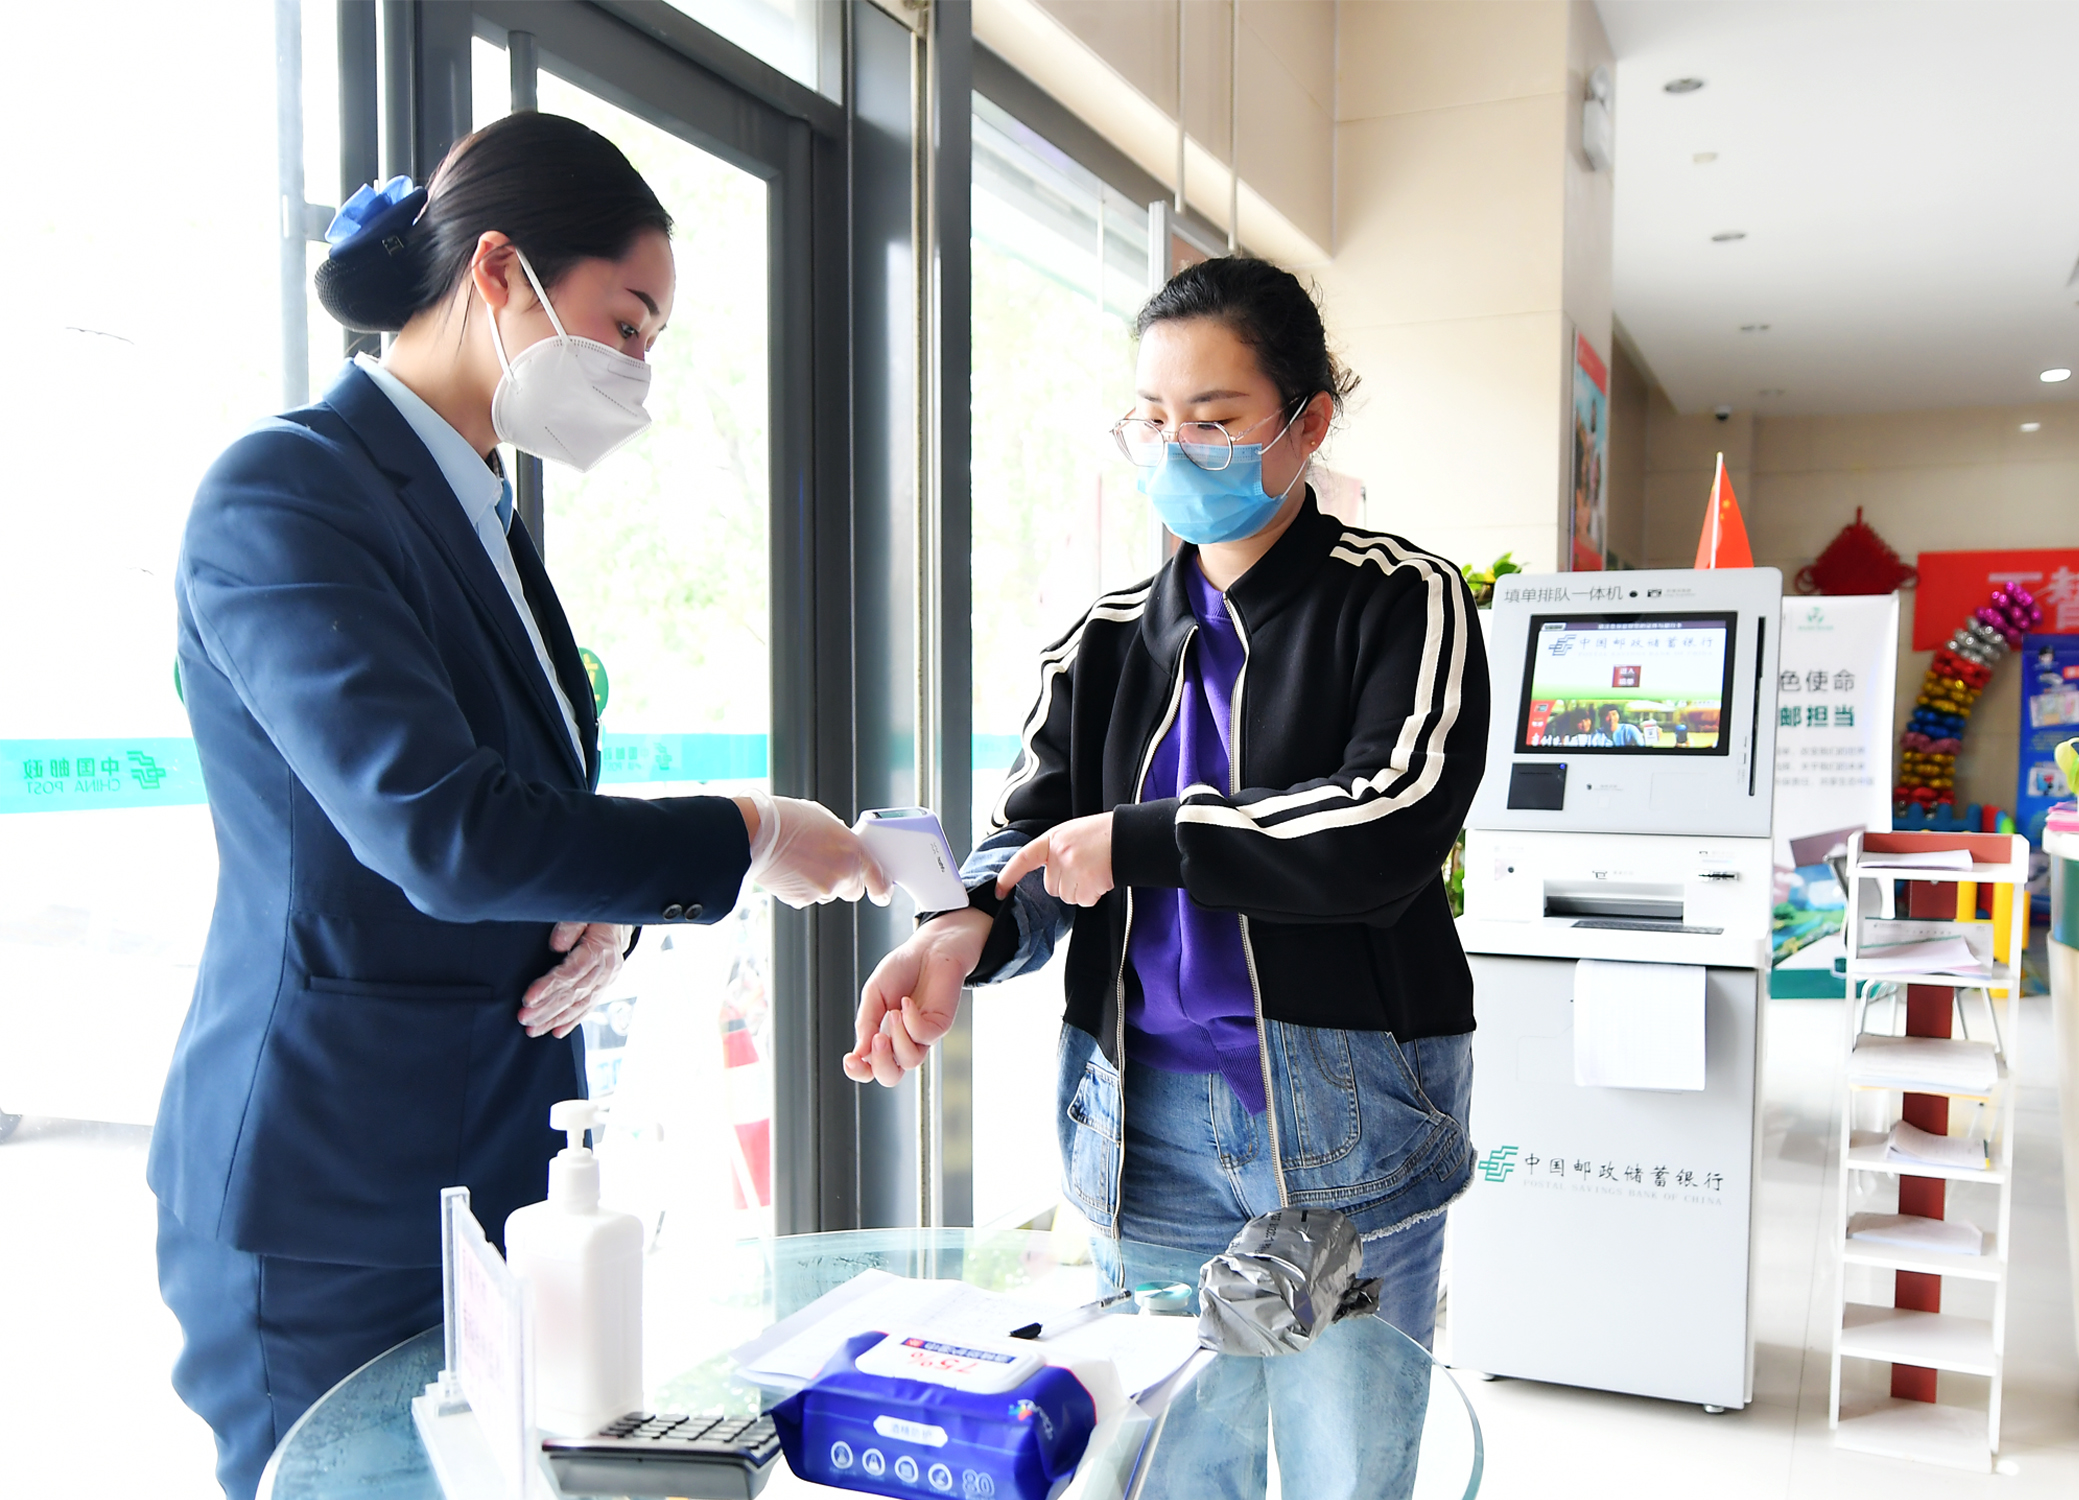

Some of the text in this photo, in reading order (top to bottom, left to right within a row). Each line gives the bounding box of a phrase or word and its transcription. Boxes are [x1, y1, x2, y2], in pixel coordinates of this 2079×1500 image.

[1504, 586, 1624, 604] 填单排队一体机
[1780, 669, 1854, 692] 色使命
[1524, 1153, 1724, 1191] 中国邮政储蓄银行
[1523, 1178, 1566, 1191] POSTAL
[1571, 1183, 1623, 1196] SAVINGS
[1628, 1188, 1658, 1200] BANK
[1683, 1194, 1722, 1206] CHINA
